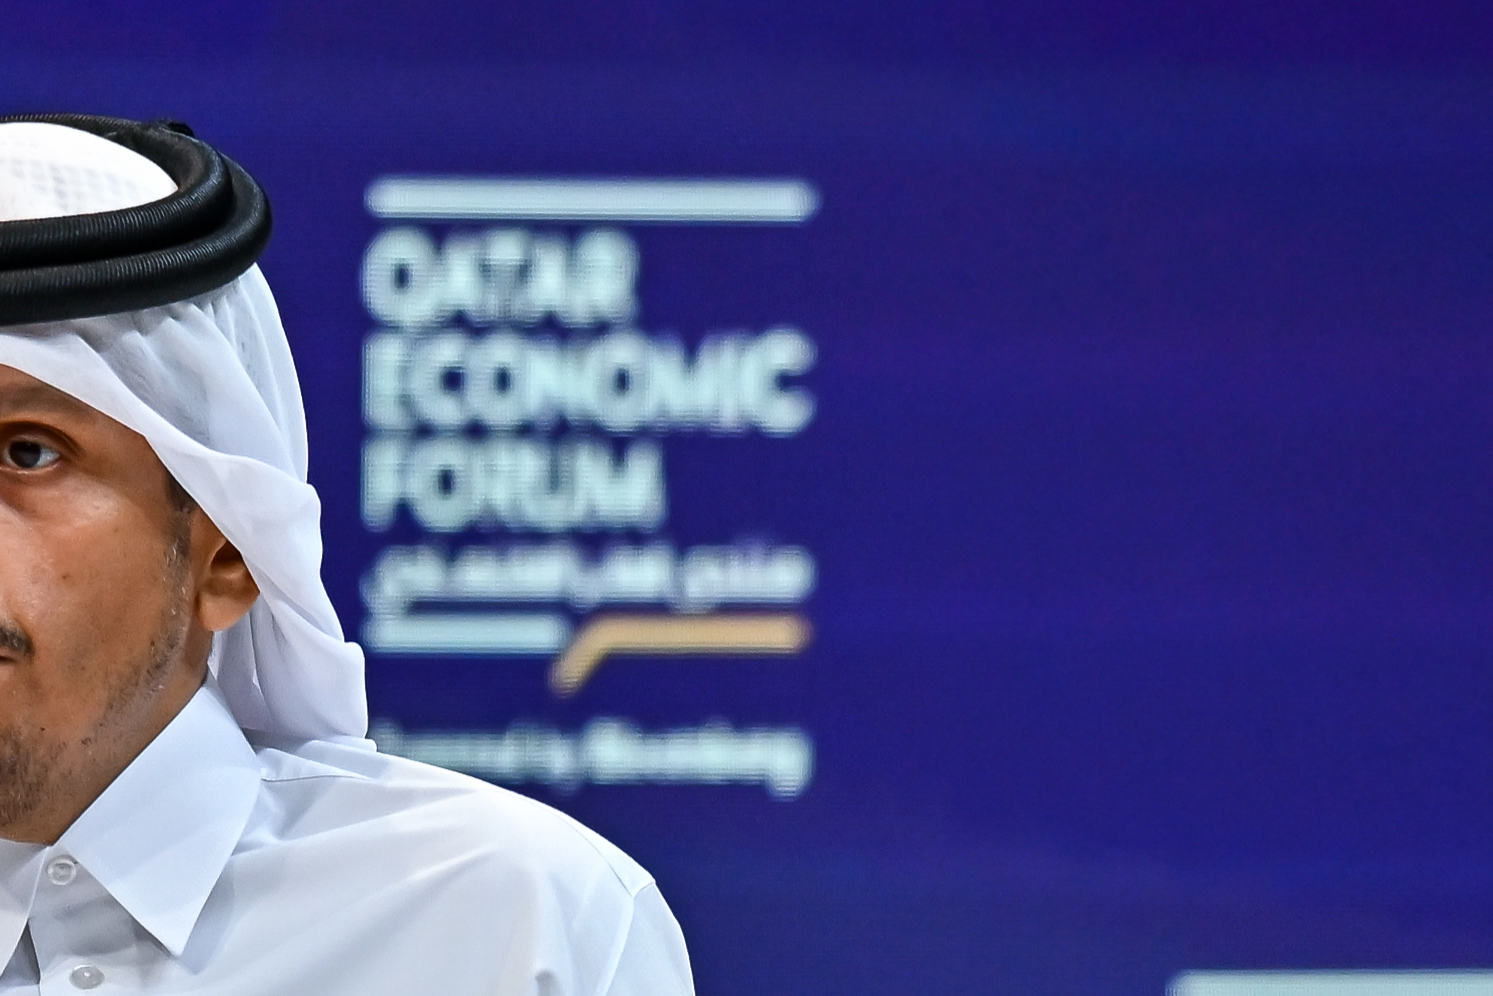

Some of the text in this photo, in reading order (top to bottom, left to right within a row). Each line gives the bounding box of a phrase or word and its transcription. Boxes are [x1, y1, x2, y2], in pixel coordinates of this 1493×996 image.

[363, 229, 638, 329] QATAR
[363, 330, 814, 437] ECONOMIC
[363, 435, 667, 533] FORUM
